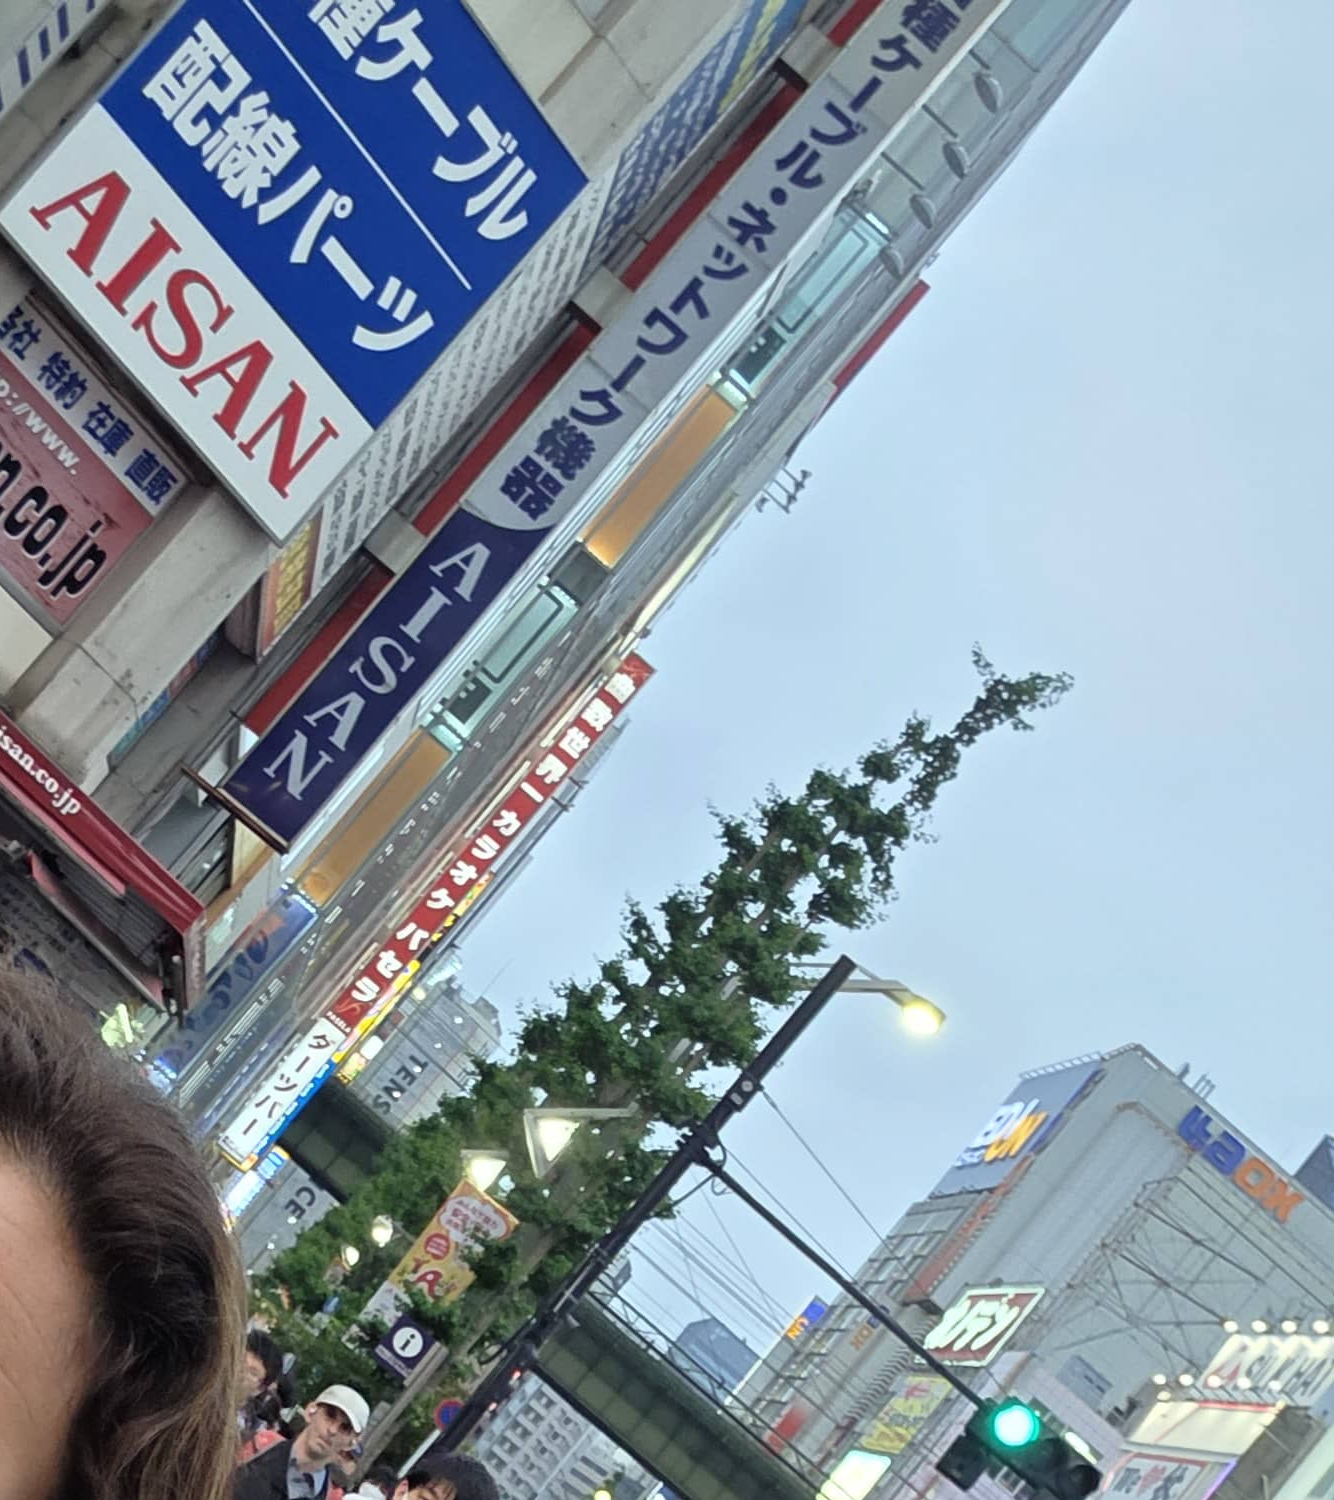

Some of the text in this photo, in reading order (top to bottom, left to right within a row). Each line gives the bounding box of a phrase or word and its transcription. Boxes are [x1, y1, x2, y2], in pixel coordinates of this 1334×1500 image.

[142, 19, 435, 353] 配線パーツ
[29, 170, 340, 500] AISAN
[263, 540, 493, 801] AISAN
[350, 808, 523, 1004] カラオケ パセラ
[242, 1033, 332, 1136] ダーツバー
